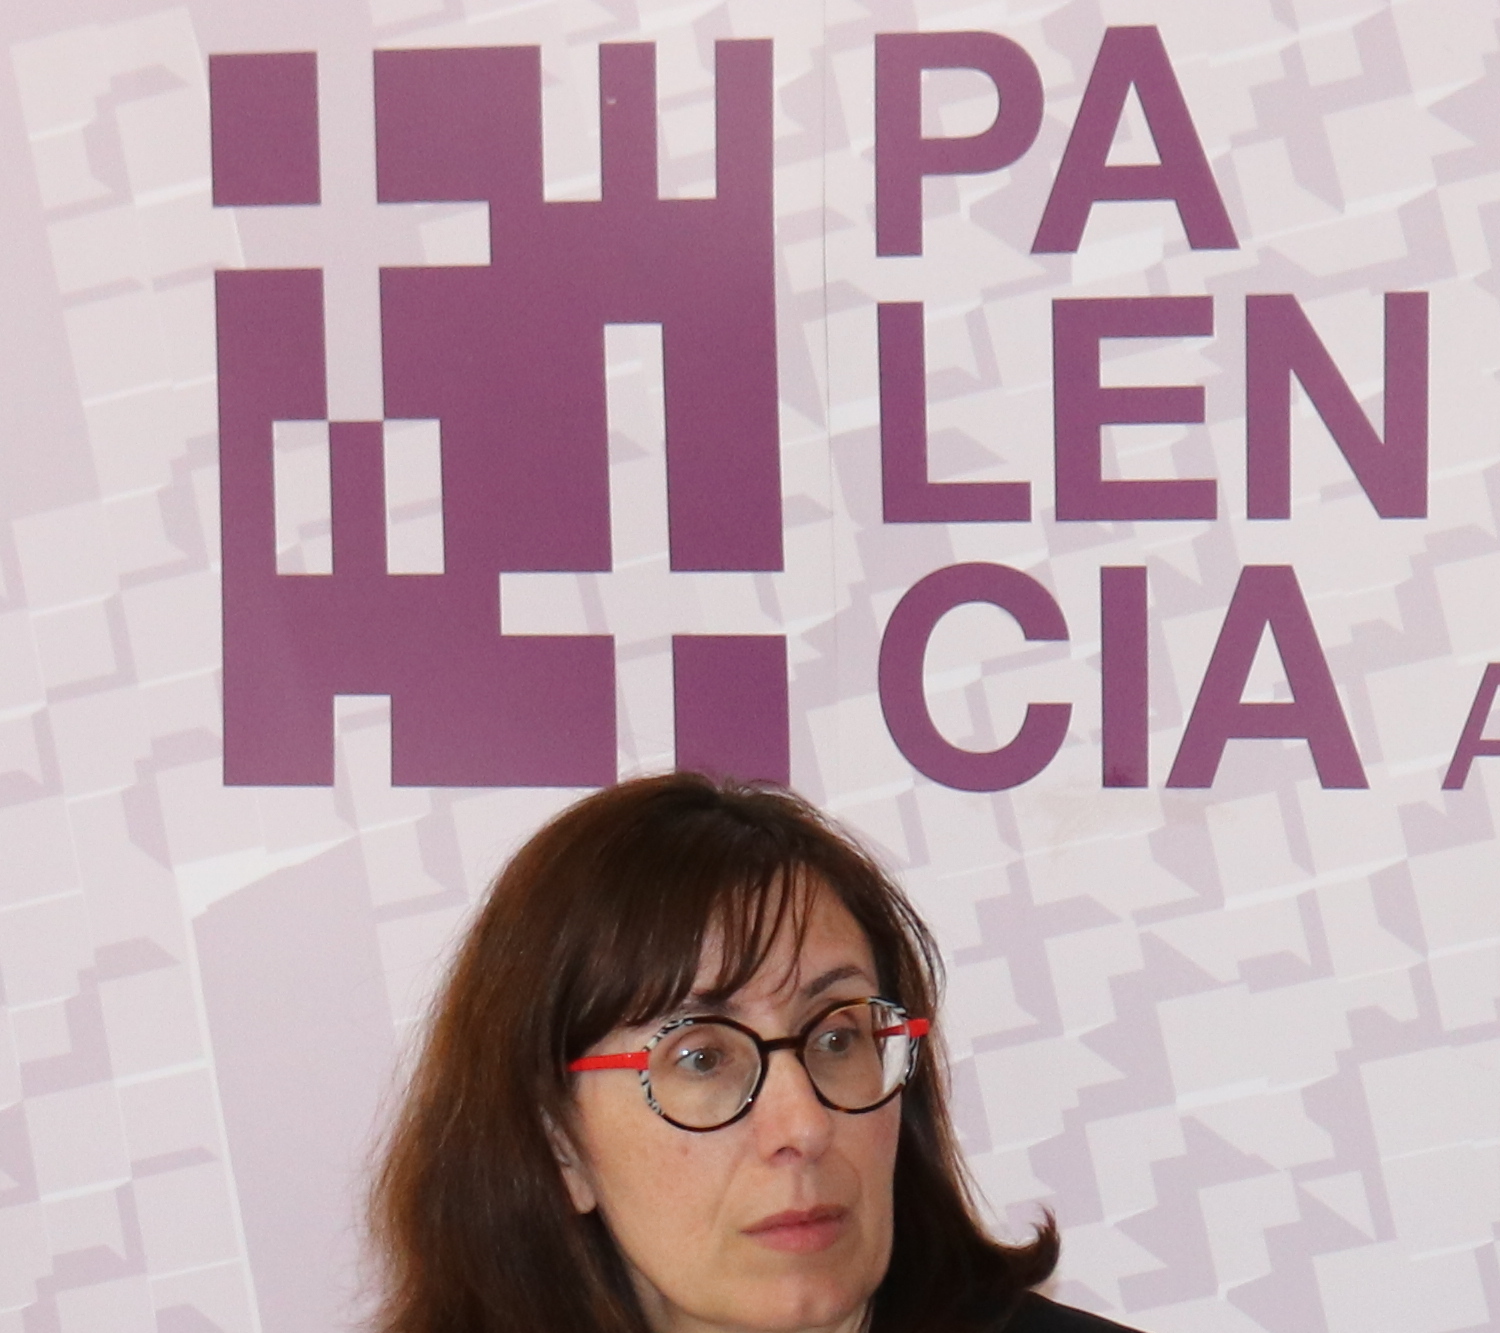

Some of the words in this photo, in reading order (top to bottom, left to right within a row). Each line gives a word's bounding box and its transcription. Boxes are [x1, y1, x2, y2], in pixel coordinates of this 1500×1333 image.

[876, 27, 1237, 256] PA
[878, 293, 1427, 523] LEN
[878, 563, 1367, 792] CIA
